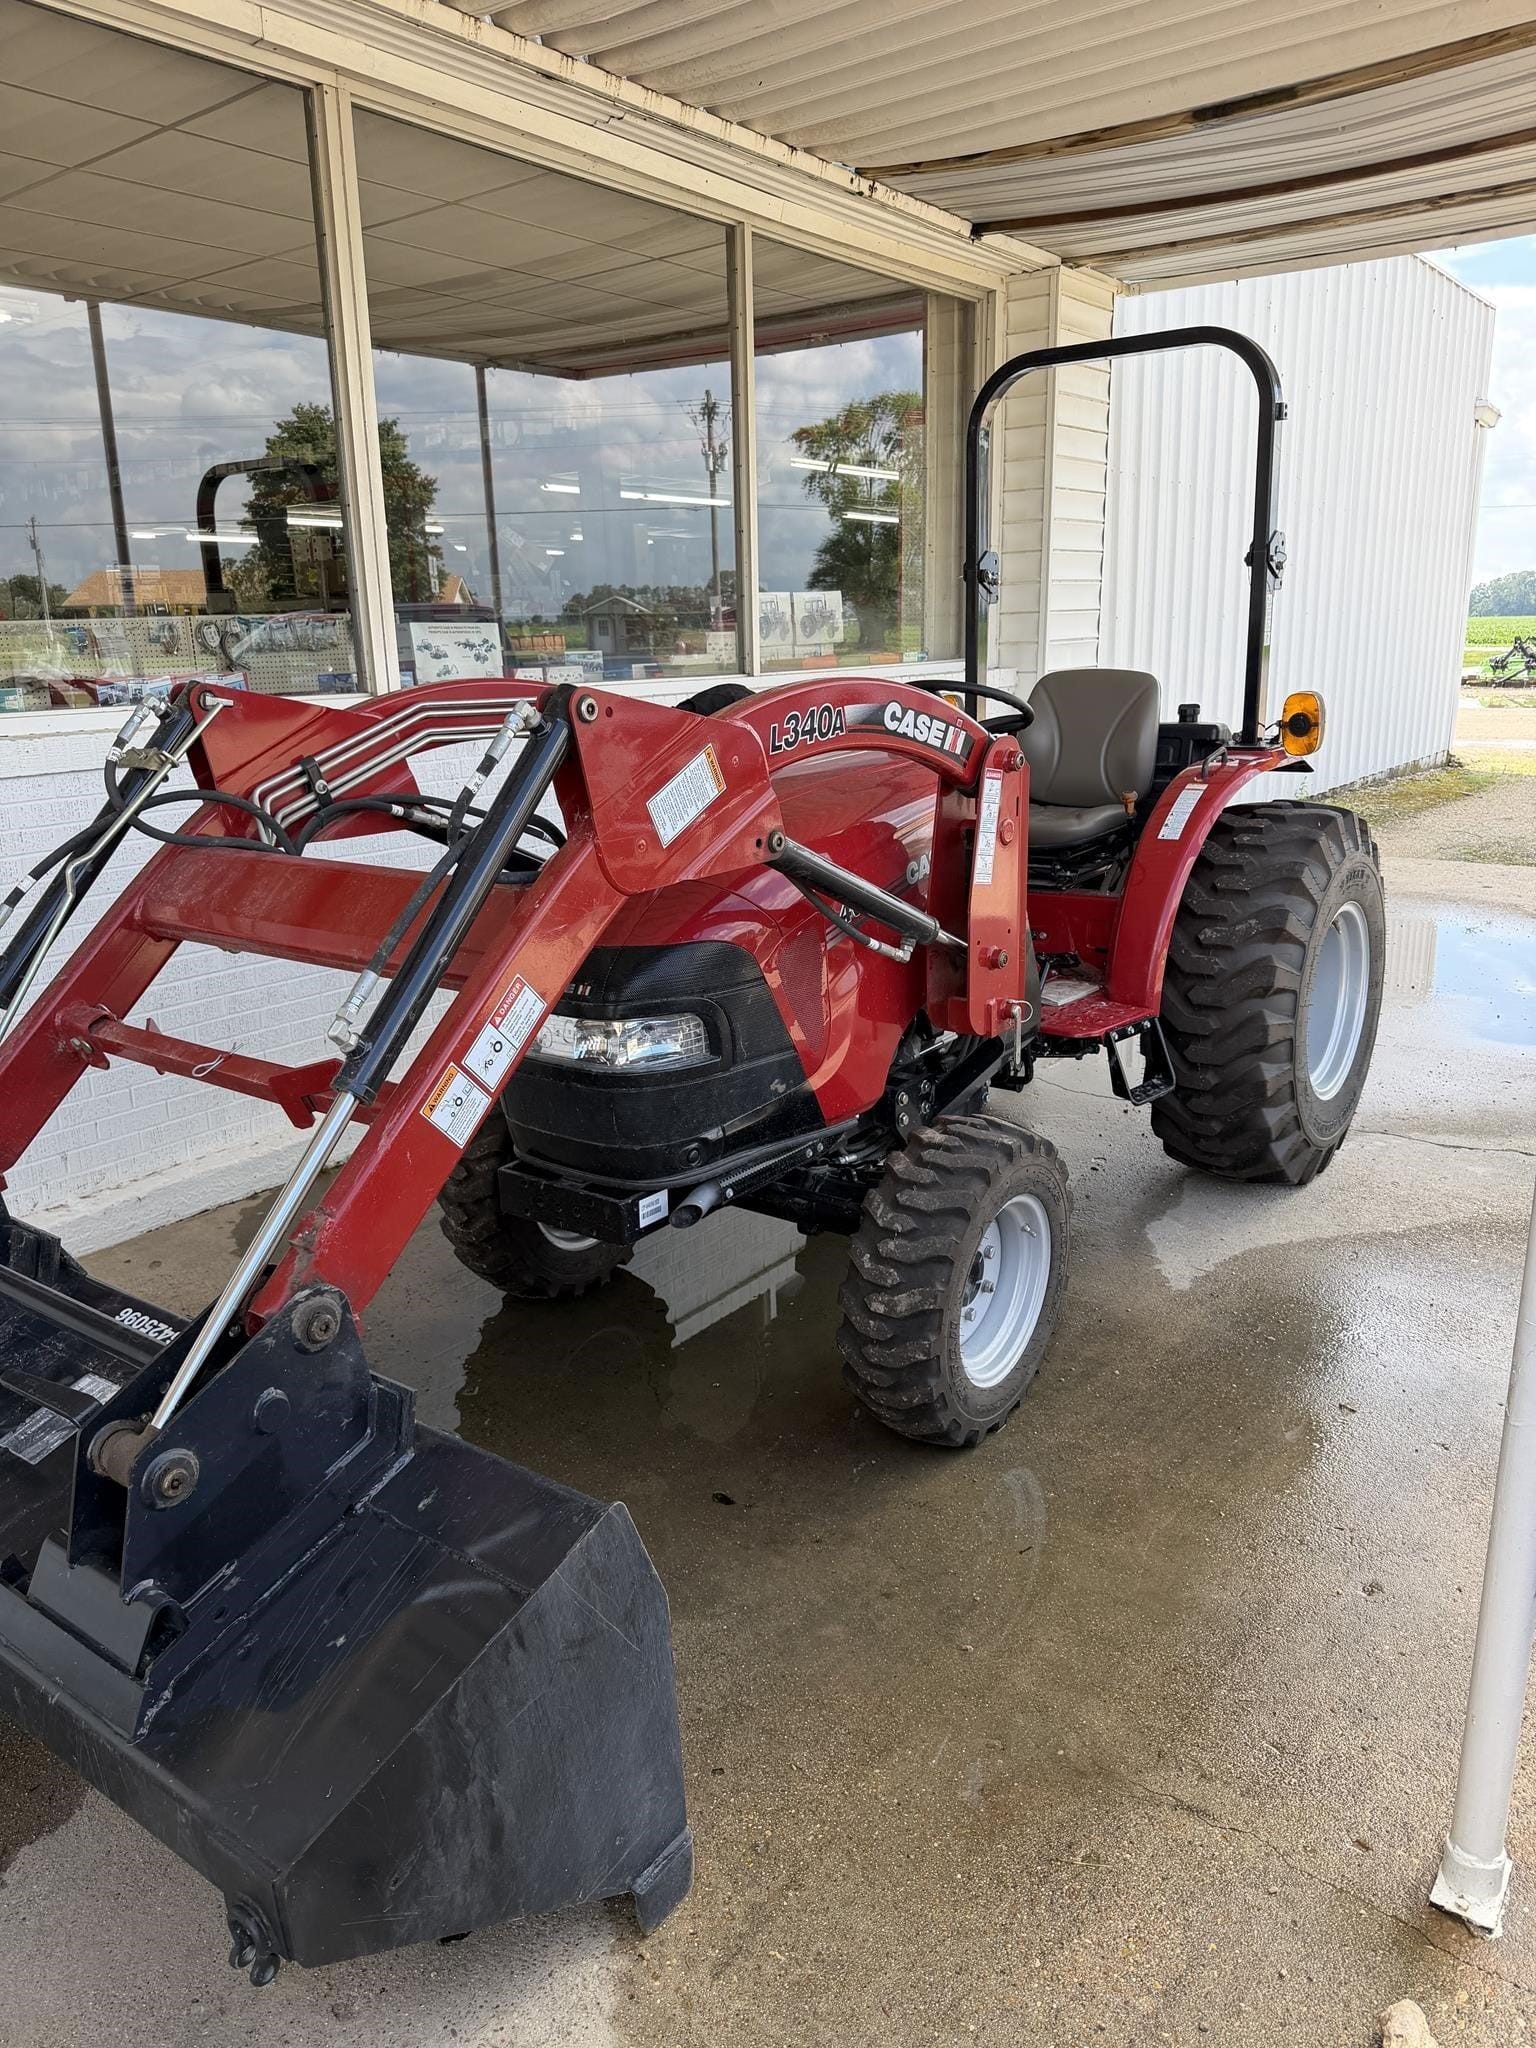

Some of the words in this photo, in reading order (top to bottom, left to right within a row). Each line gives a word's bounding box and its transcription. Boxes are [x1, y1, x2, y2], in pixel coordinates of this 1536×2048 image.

[769, 703, 846, 755] L340A
[884, 701, 944, 748] CASE
[499, 981, 523, 1015] DANGER
[433, 1073, 455, 1106] WARNING
